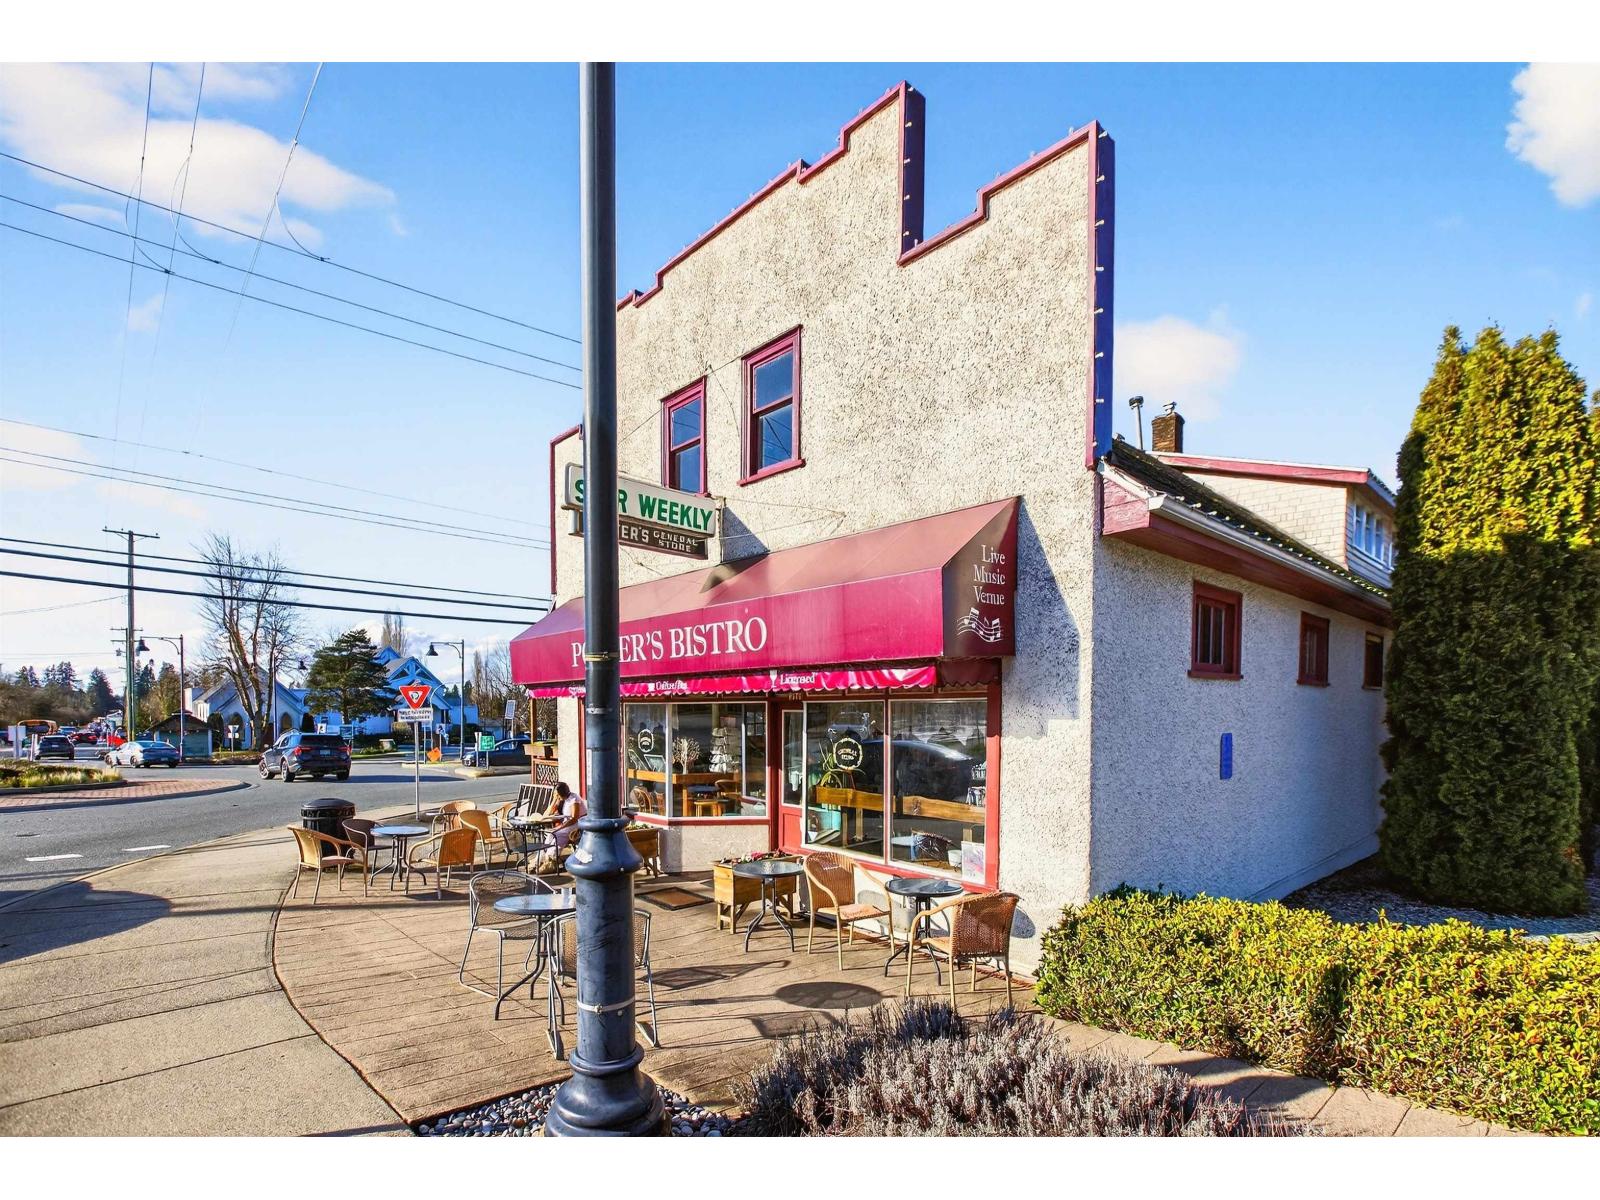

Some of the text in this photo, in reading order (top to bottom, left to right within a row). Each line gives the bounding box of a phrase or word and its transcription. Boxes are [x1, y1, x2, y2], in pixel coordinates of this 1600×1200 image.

[575, 479, 713, 531] SR WEEKLY
[653, 530, 699, 546] GENERAL
[658, 539, 692, 553] STORE
[981, 544, 1006, 565] Live
[973, 564, 1006, 585] Music
[571, 616, 768, 668] PER'S BISTRO
